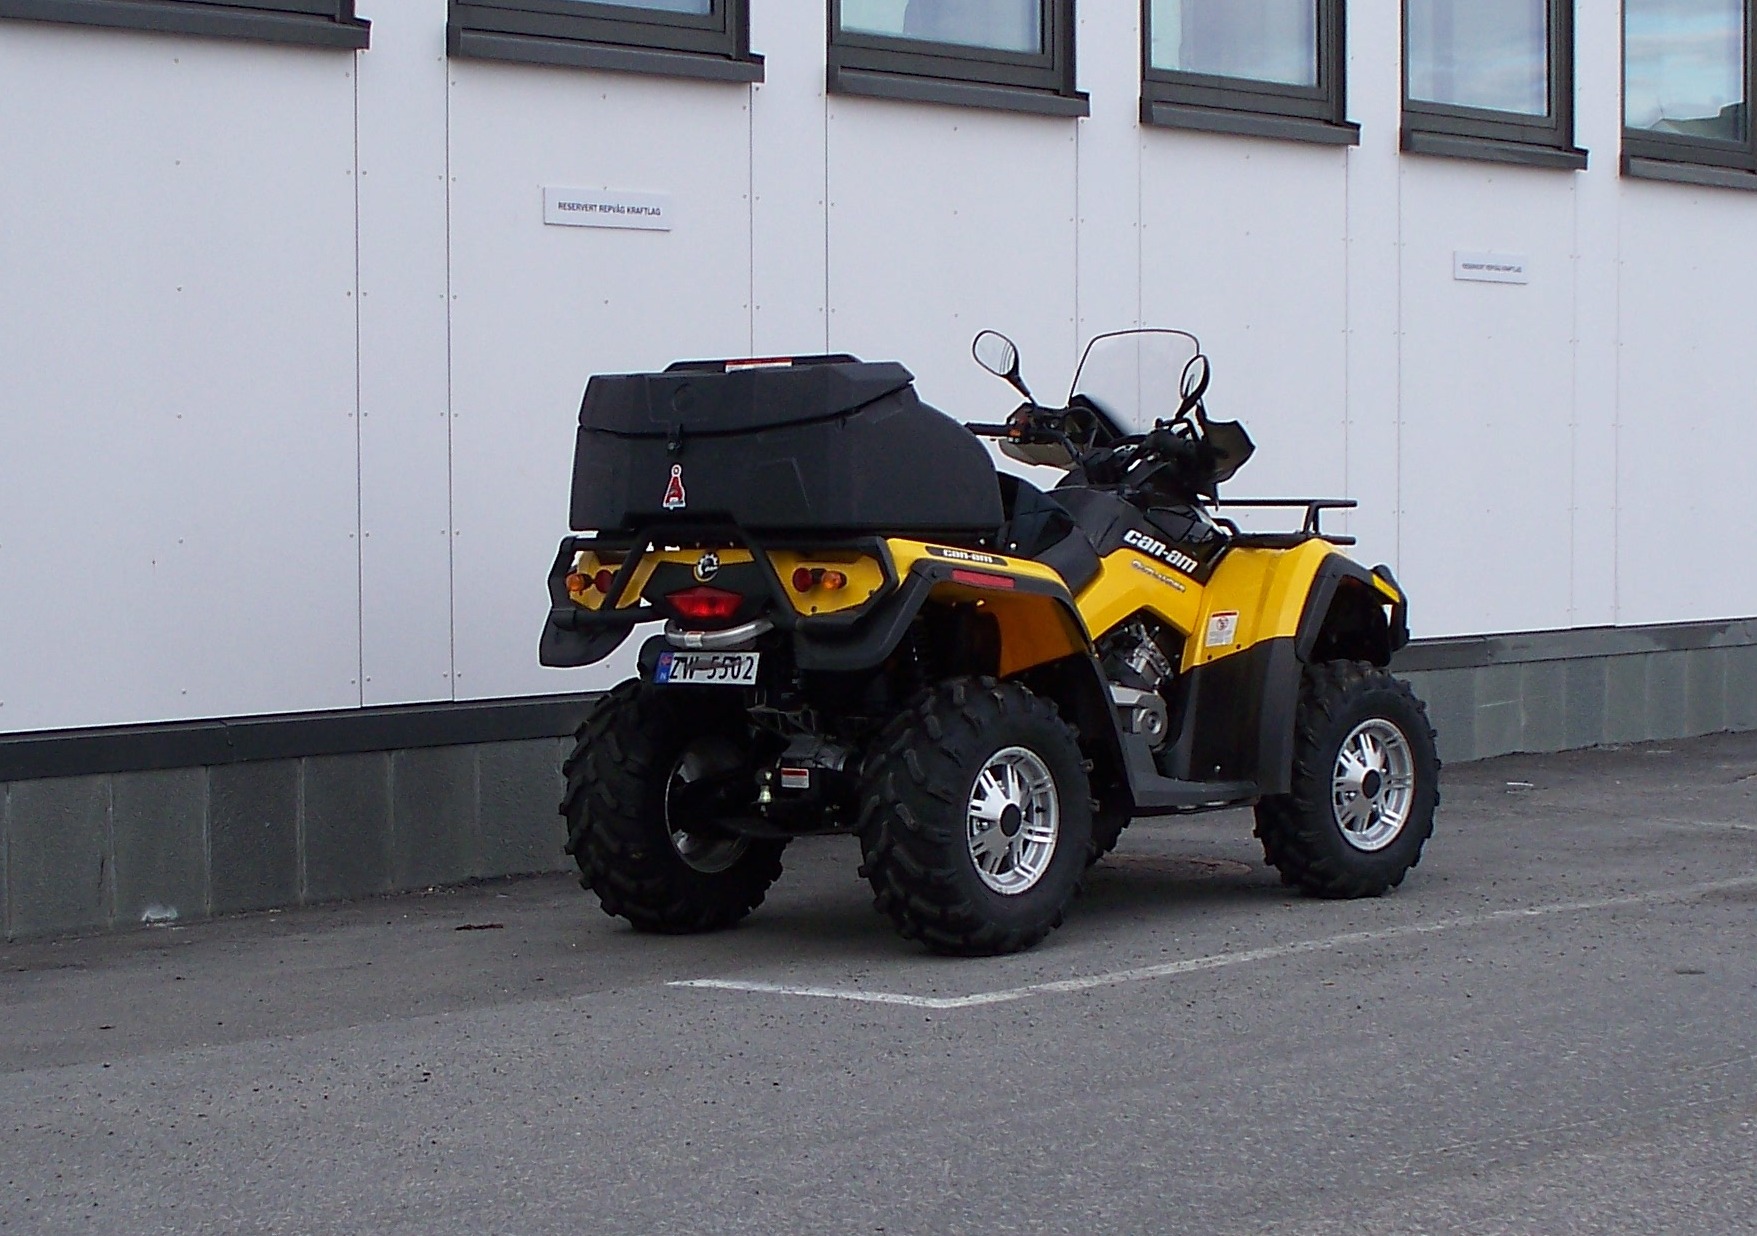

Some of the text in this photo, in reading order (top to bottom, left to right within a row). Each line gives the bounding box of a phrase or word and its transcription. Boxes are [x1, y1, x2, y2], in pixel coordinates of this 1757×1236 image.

[558, 202, 597, 212] RESERVERT
[627, 206, 661, 215] KRAFTLAG
[943, 549, 993, 563] can-am
[1123, 529, 1198, 573] can-am
